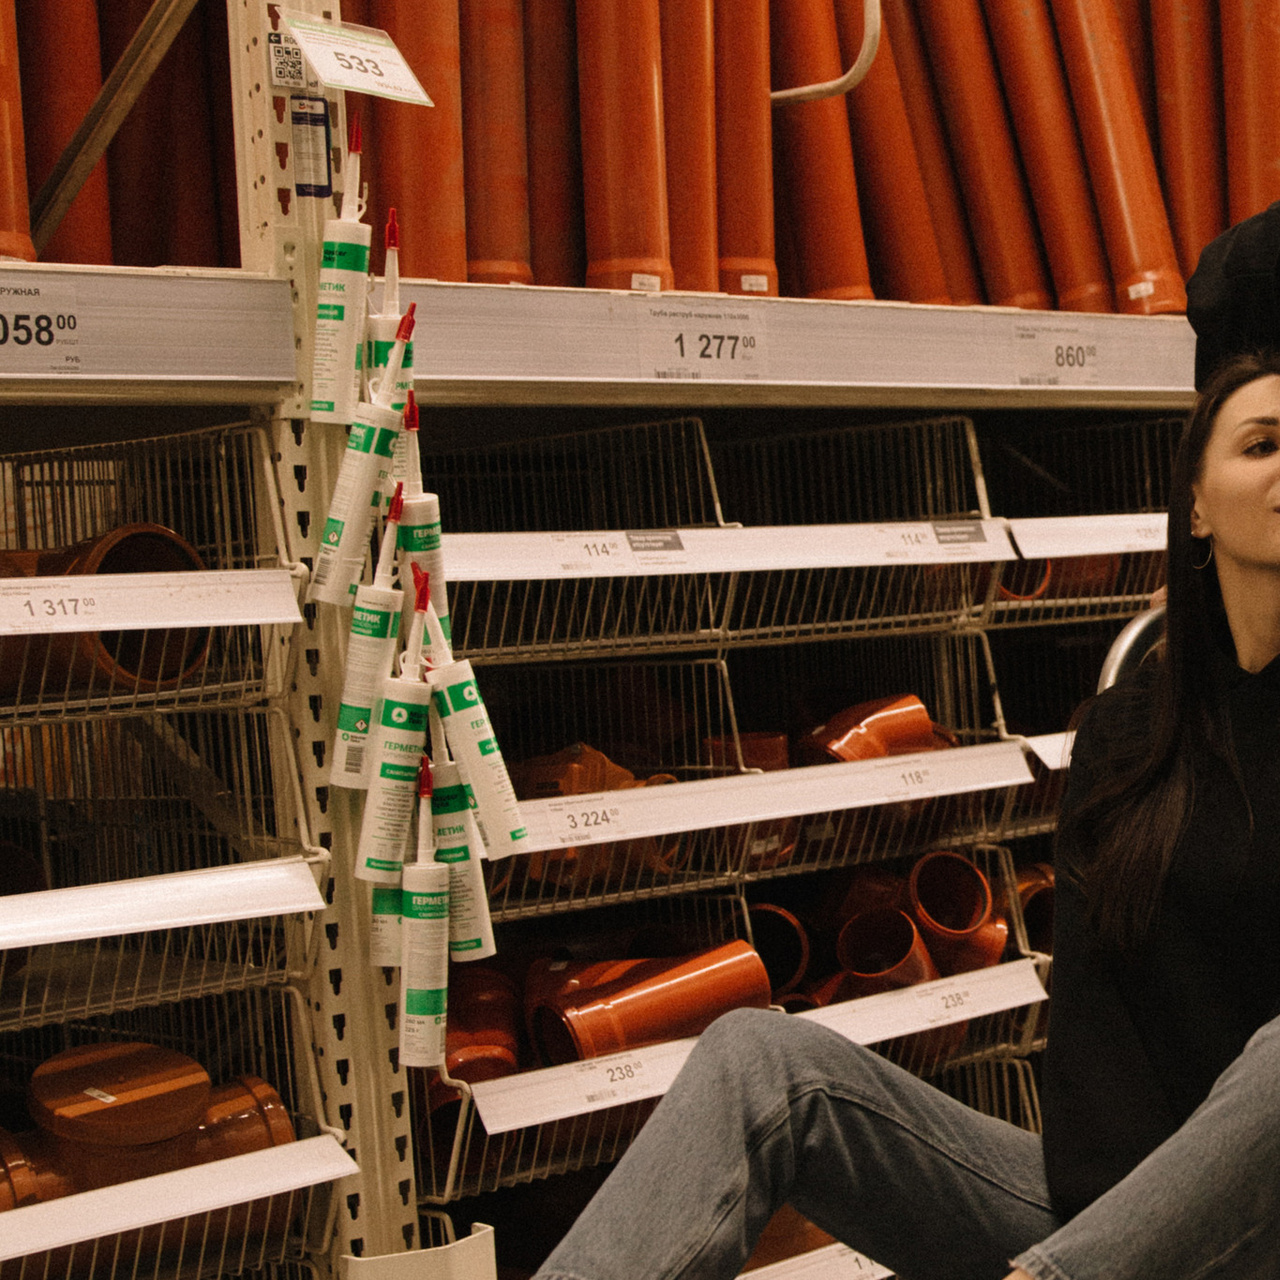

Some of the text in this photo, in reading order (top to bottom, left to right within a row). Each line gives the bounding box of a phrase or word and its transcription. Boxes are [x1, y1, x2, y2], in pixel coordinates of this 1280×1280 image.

[334, 51, 384, 77] 533
[0, 287, 40, 296] РУЖНАЯ
[56, 314, 77, 330] 00
[674, 333, 684, 358] 1
[698, 334, 740, 359] 277
[1055, 346, 1085, 368] 860
[901, 533, 921, 546] 114
[584, 543, 609, 556] 114
[23, 600, 34, 616] 1
[43, 598, 79, 616] 317
[901, 771, 923, 786] 118
[567, 814, 578, 829] 3
[581, 810, 610, 827] 224
[941, 992, 964, 1009] 238
[606, 1064, 635, 1083] 238
